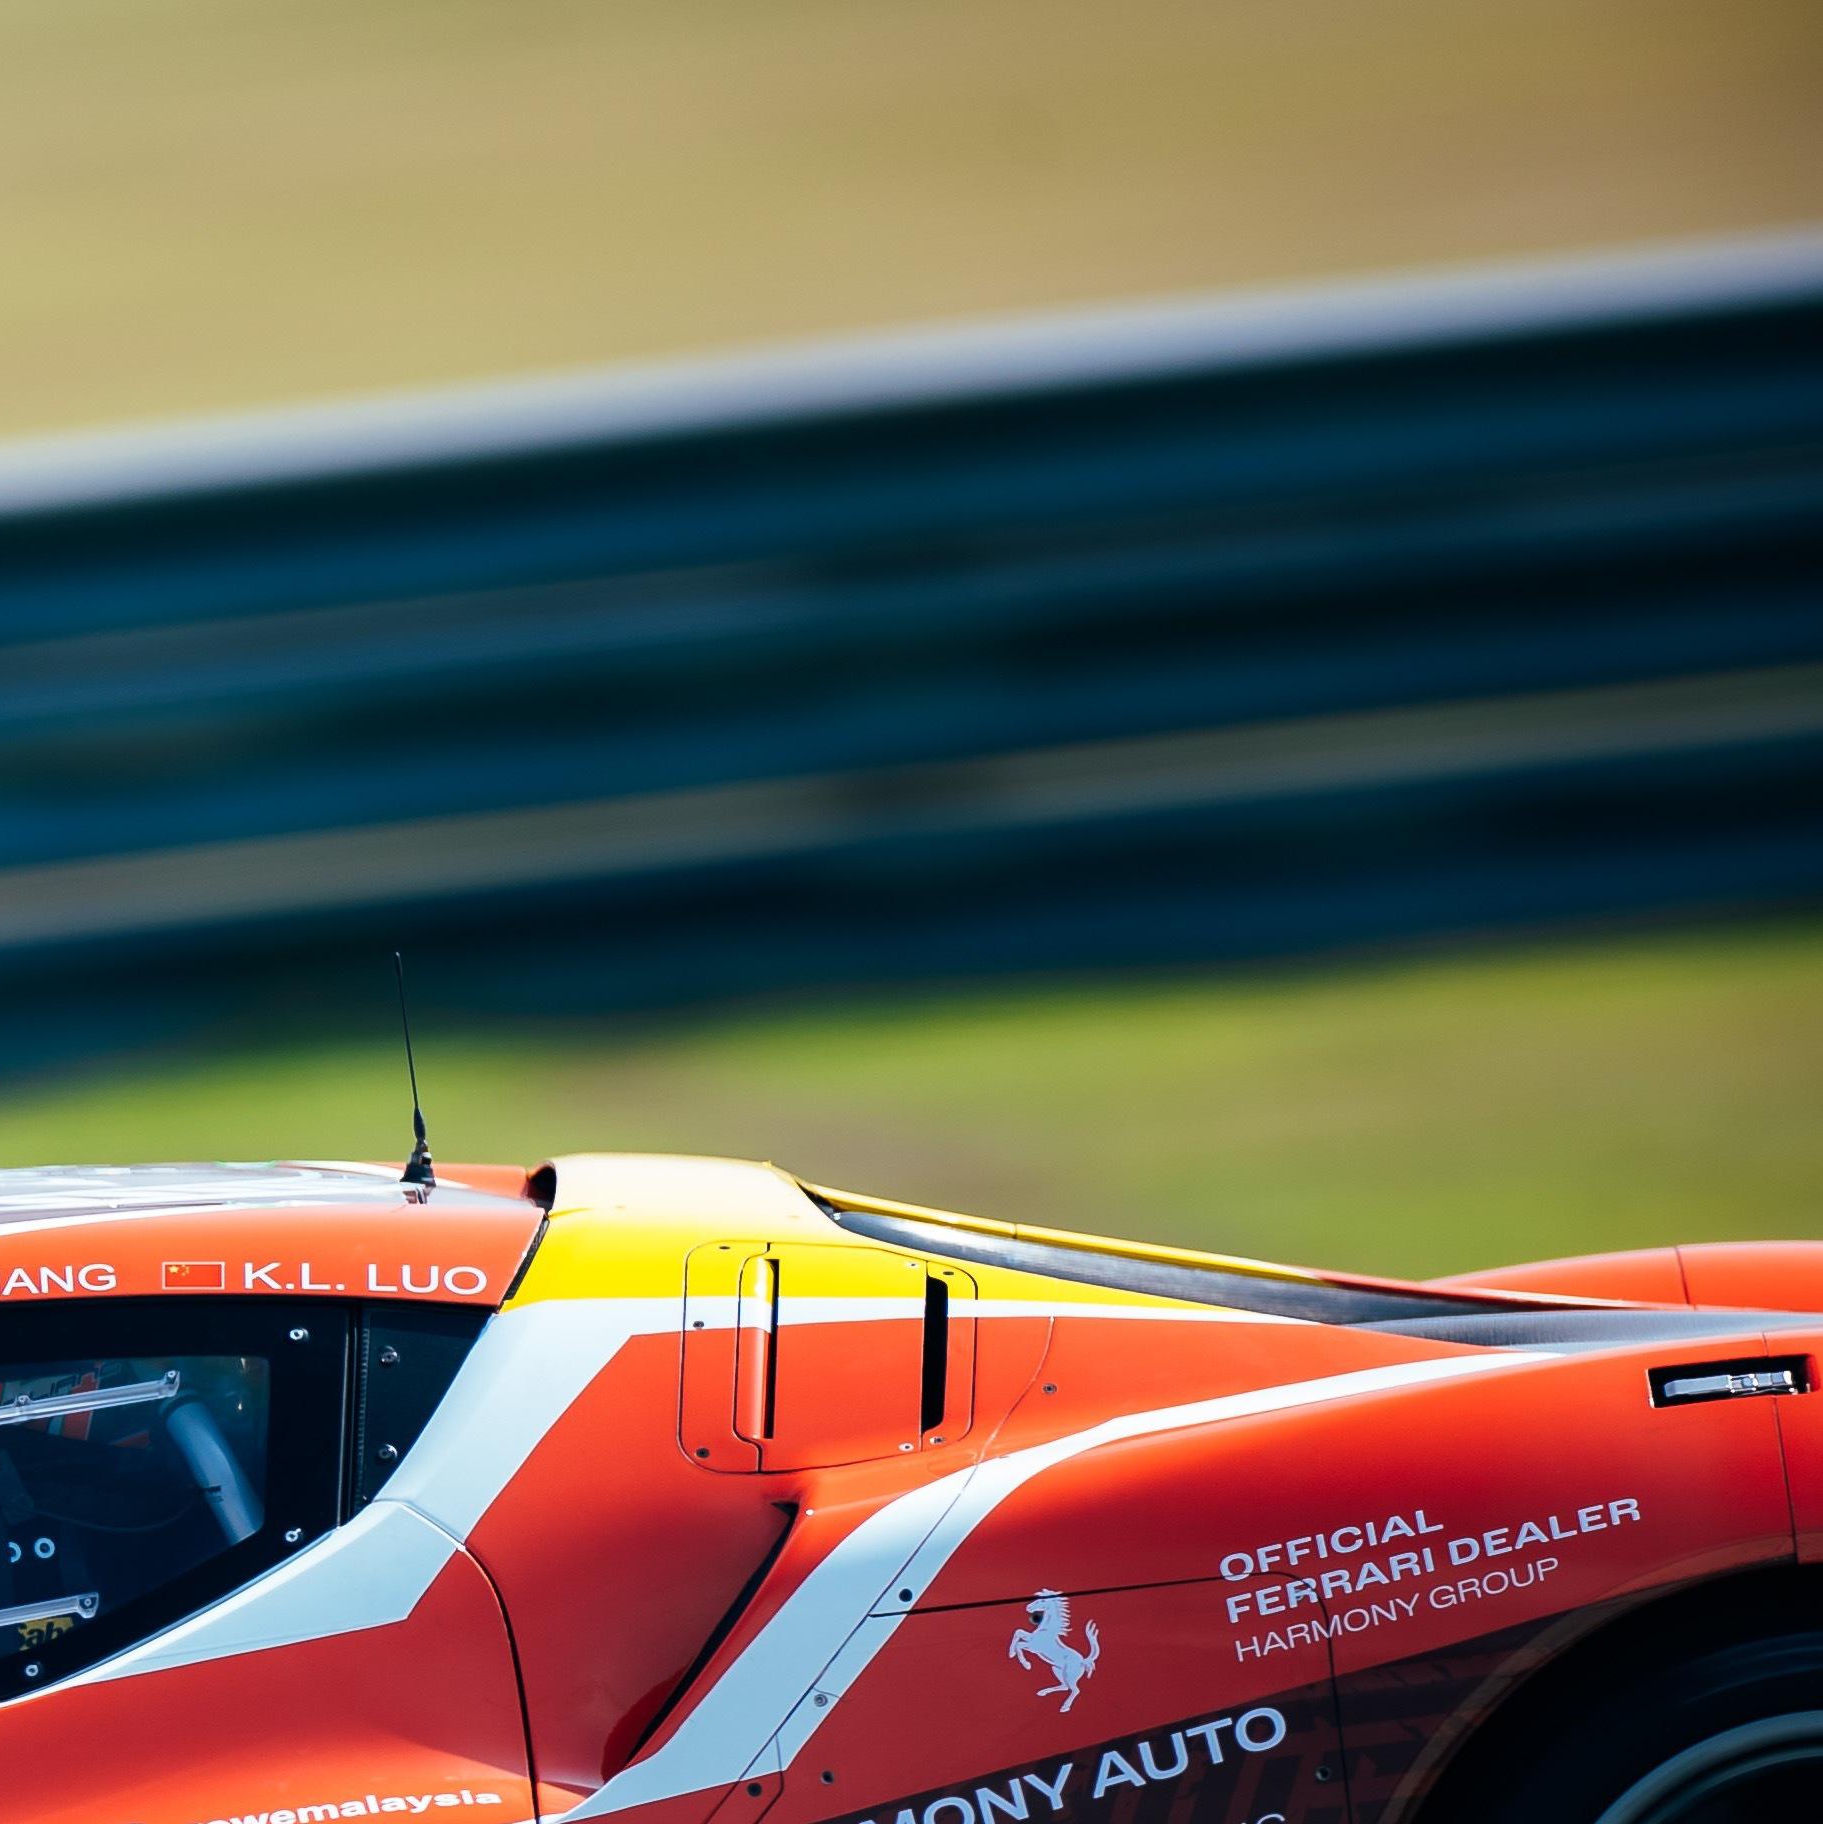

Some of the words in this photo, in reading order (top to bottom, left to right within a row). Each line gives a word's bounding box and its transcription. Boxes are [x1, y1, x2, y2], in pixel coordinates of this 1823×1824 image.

[243, 1261, 345, 1291] K.L.
[367, 1263, 488, 1296] LUO
[1218, 1509, 1444, 1582] OFFICIAL
[1225, 1547, 1435, 1624] FERRARI
[1449, 1497, 1641, 1567] DEALER
[1235, 1592, 1421, 1662] HARMONY
[1429, 1556, 1559, 1608] GROUP
[1092, 1706, 1288, 1799] AUTO
